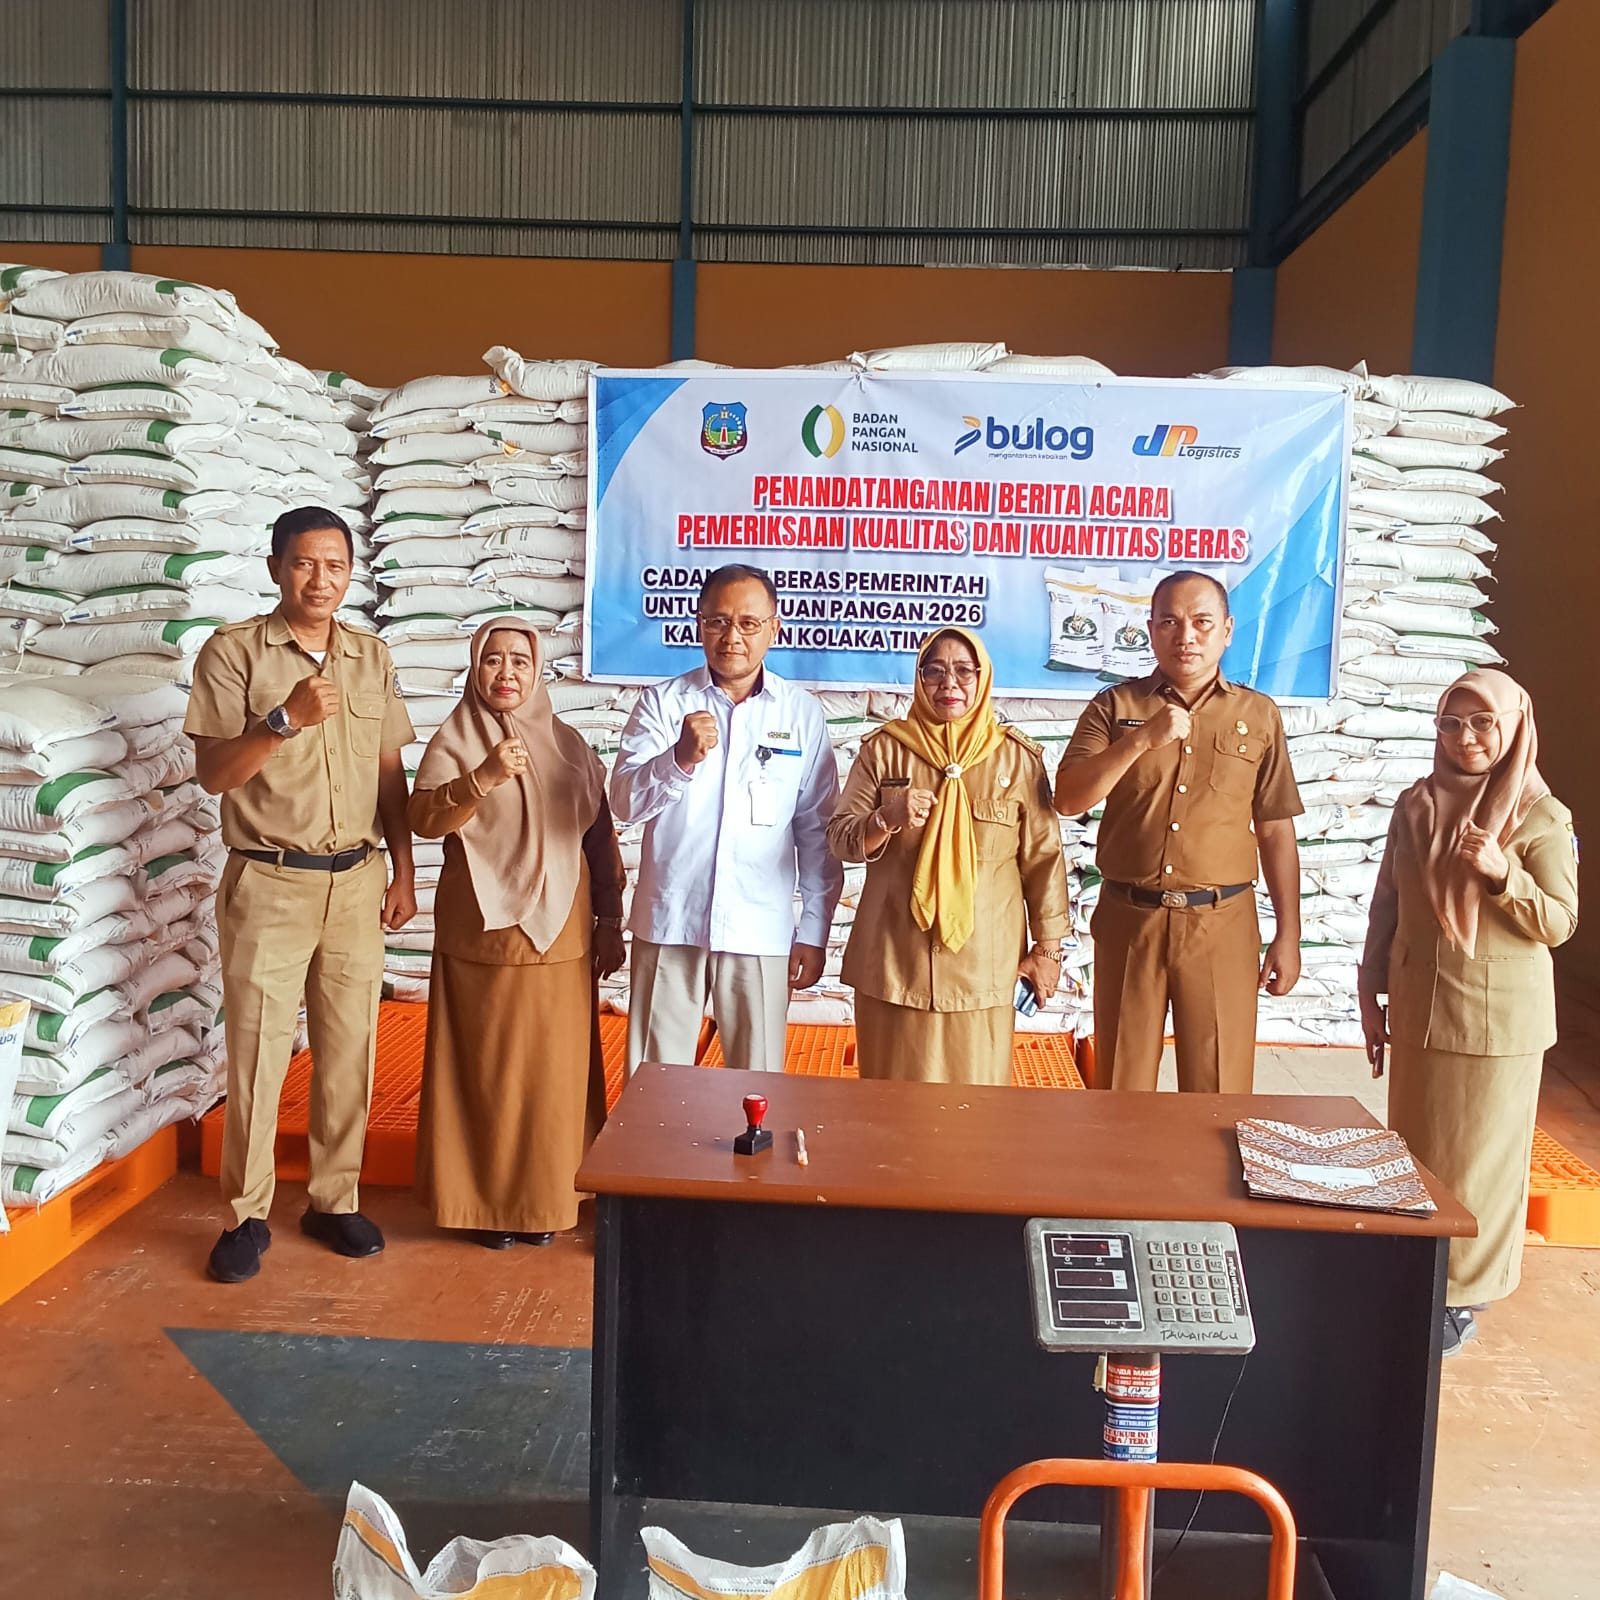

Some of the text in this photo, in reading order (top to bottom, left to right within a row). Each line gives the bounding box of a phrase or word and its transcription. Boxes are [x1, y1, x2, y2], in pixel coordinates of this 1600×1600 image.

[853, 412, 898, 424] BADAN
[852, 427, 906, 439] PANGAN
[986, 416, 1094, 461] bulog
[852, 441, 919, 453] NASIONAL
[1178, 446, 1241, 460] Logistics
[988, 452, 1037, 460] mengantarkan
[753, 476, 1168, 518] PENANDATANGANAN BERITA ACARA
[678, 515, 1246, 560] PEMERIKSAAN KUALITAS DAN KUANTITAS BERAS
[775, 571, 841, 590] BERAS
[845, 572, 984, 595] PEMERINTAH
[645, 596, 701, 615] UNTU
[830, 600, 924, 622] PANGAN
[928, 603, 981, 622] 2026
[799, 627, 885, 649] KOLAKA
[889, 630, 932, 650] TIM
[1172, 1243, 1180, 1252] 8
[1191, 1244, 1198, 1253] 9
[1156, 1260, 1163, 1269] 4
[1175, 1260, 1183, 1269] 5
[1194, 1260, 1202, 1269] 6
[1178, 1276, 1185, 1285] 2
[1196, 1276, 1204, 1285] 3
